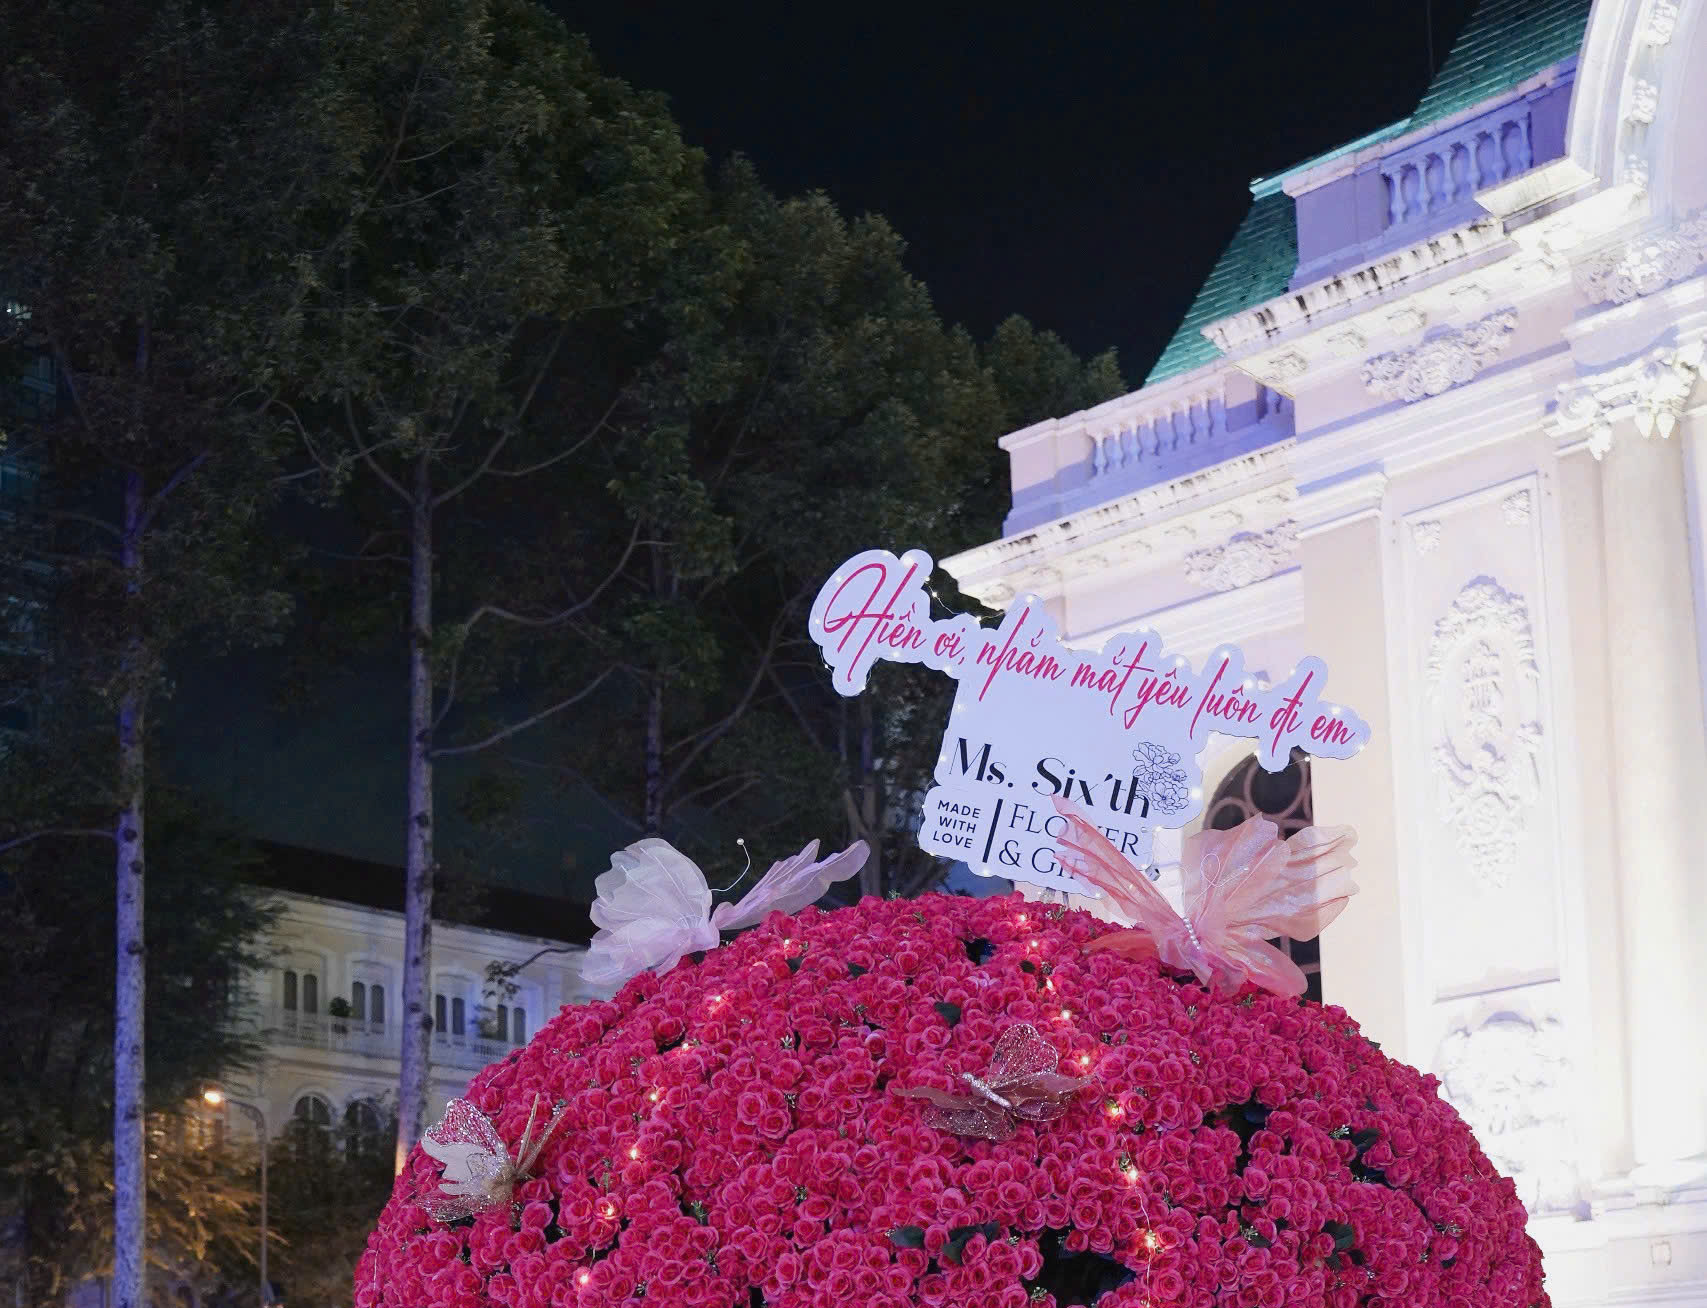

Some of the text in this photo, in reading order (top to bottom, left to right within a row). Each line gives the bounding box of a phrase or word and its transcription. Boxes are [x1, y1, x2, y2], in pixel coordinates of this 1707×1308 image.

[823, 562, 927, 682] Hiền
[976, 606, 1067, 702] nhắm
[1070, 640, 1155, 716] mắt
[1123, 667, 1193, 730] yêu
[1189, 657, 1263, 740] luôn
[1269, 670, 1314, 757] đi
[1310, 713, 1356, 745] em
[948, 736, 1151, 819] Ms. Six'th
[937, 799, 982, 819] MADE
[939, 815, 978, 834] WITH
[932, 830, 974, 849] LOVE
[998, 838, 1092, 881] & GIF
